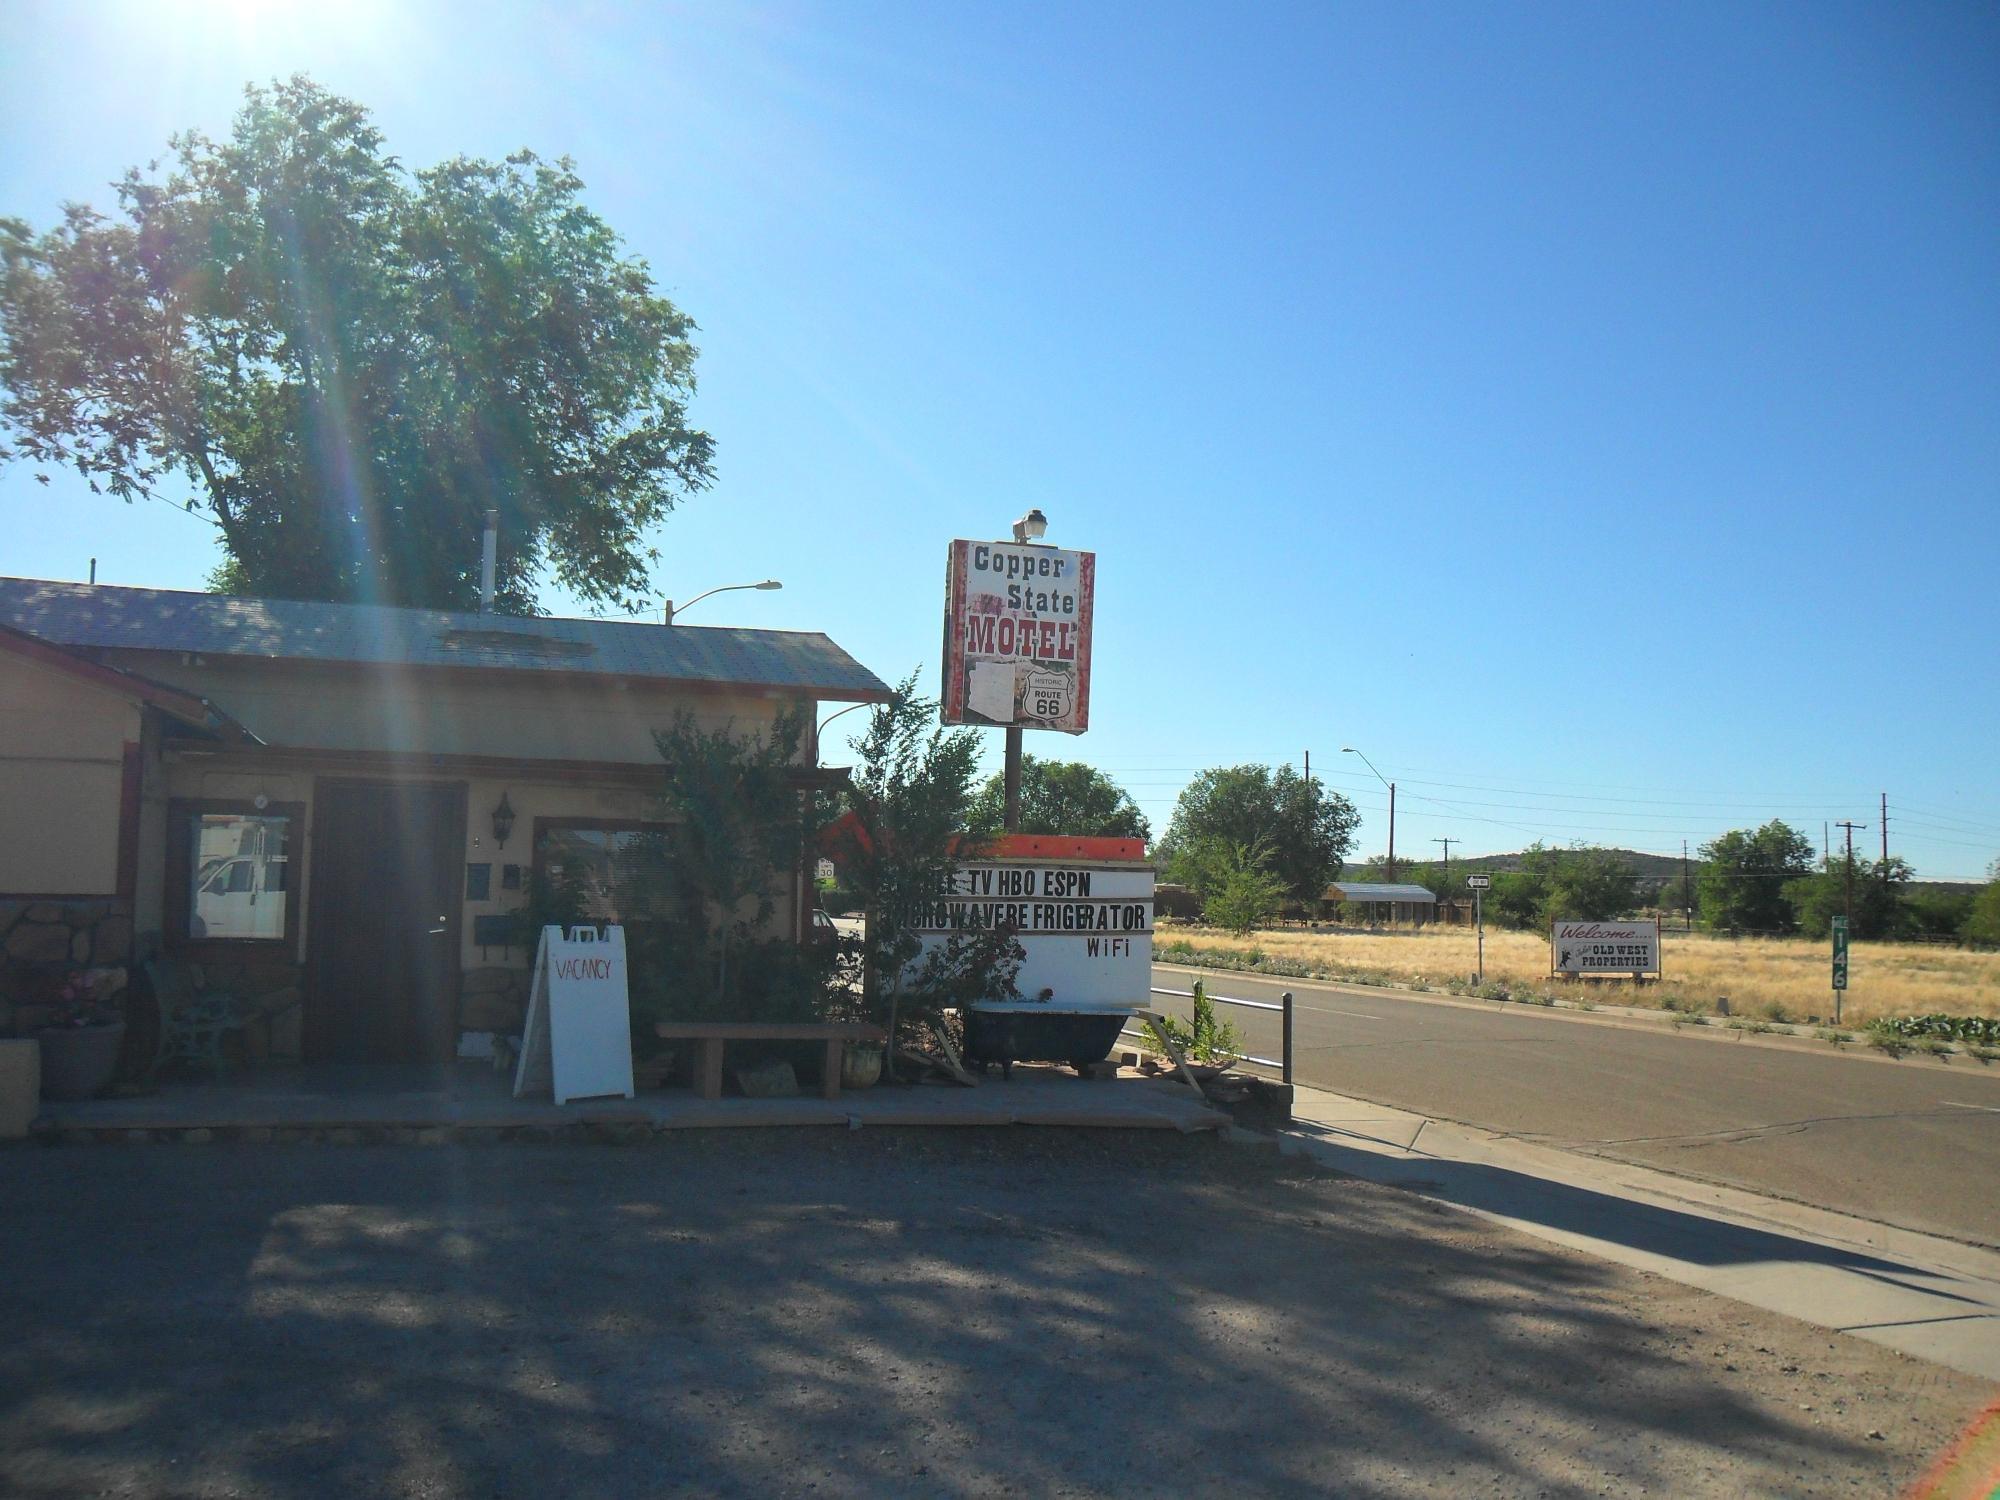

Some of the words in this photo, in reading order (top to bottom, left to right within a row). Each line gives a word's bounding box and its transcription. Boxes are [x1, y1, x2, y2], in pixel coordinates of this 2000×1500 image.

[975, 546, 1065, 580] Copper
[1008, 584, 1074, 614] State
[967, 615, 1074, 660] MOTEL
[1035, 690, 1062, 700] ROUTE
[1036, 699, 1060, 715] 66
[820, 869, 833, 877] 30
[968, 869, 993, 896] TV
[999, 870, 1036, 896] HBO
[1044, 871, 1091, 897] ESPN
[1087, 938, 1130, 958] WiFi
[1593, 945, 1615, 955] OLD
[1617, 946, 1648, 956] WEST
[555, 958, 612, 980] VACANCY
[1582, 956, 1649, 967] PROPERTIES
